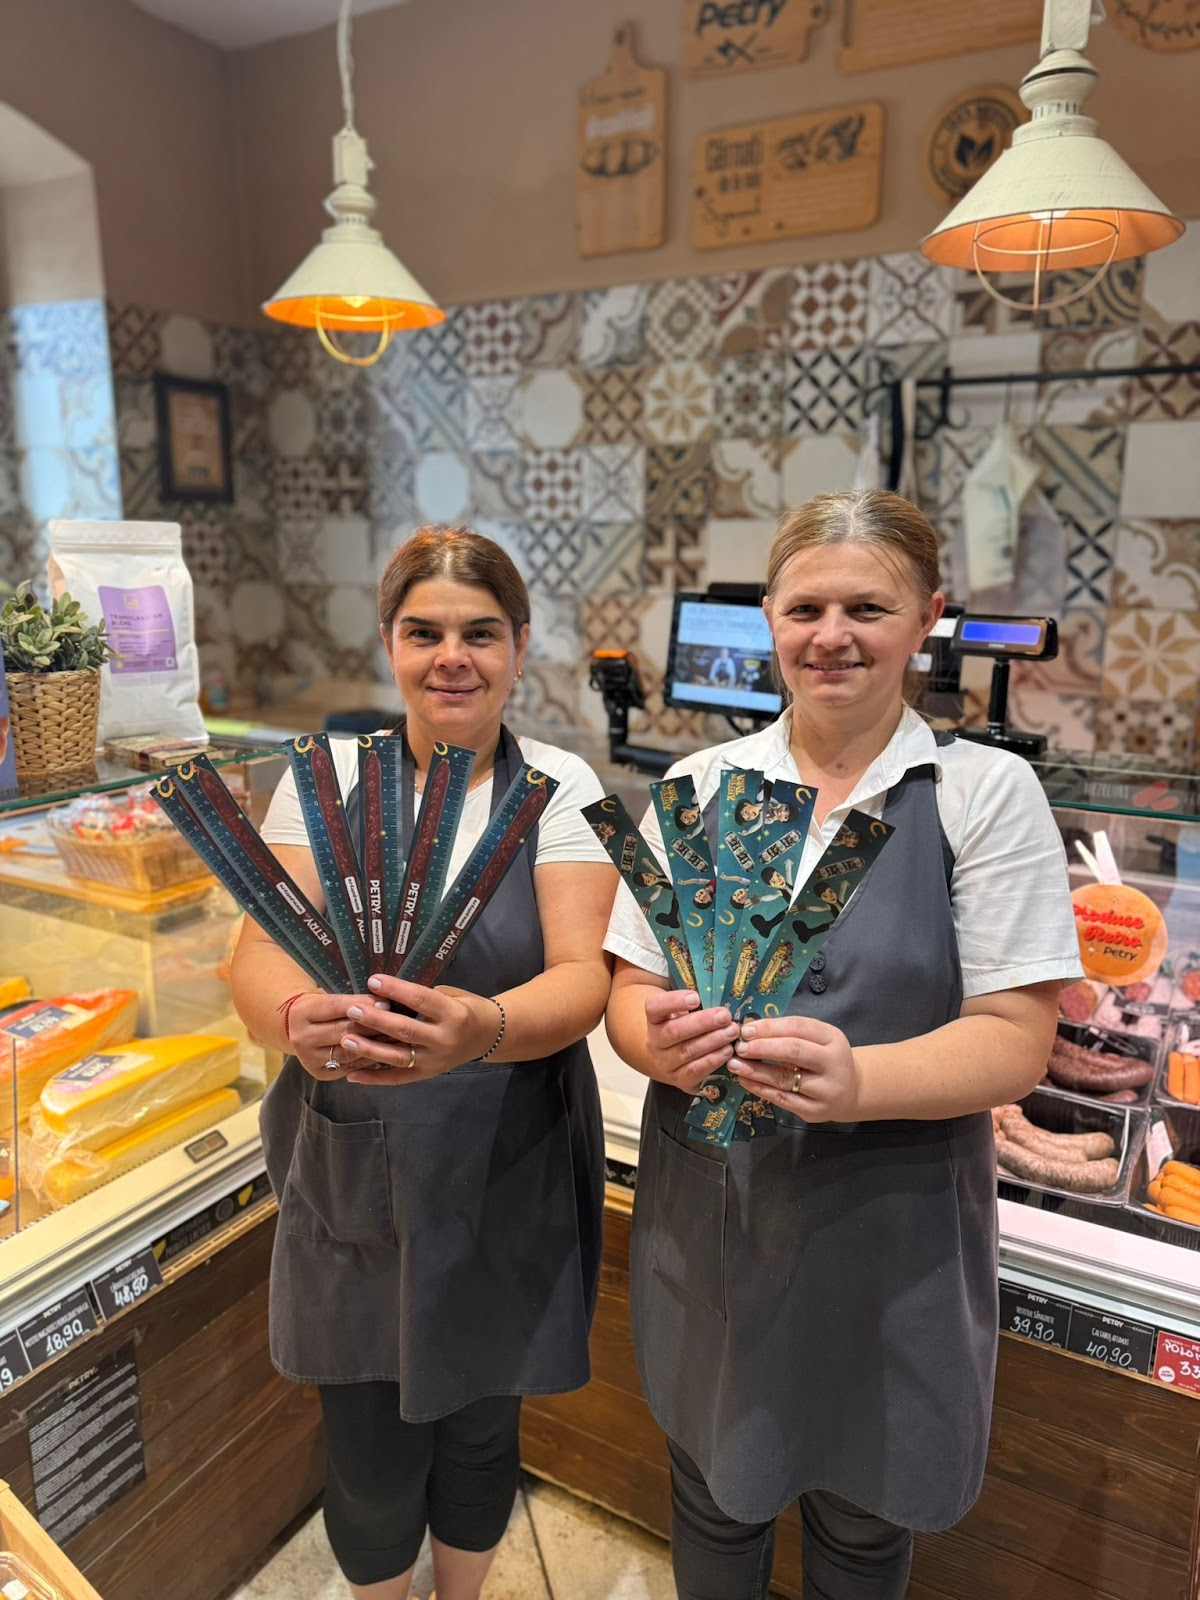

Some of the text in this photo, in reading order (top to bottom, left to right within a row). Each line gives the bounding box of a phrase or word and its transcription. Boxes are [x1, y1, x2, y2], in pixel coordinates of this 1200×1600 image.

[110, 613, 164, 621] TRANSYLVAAN
[370, 879, 382, 915] PETRY
[404, 882, 420, 917] PETRY
[303, 917, 333, 947] PETRY
[434, 930, 458, 961] PETRY
[1083, 924, 1143, 948] Retro
[114, 1274, 149, 1307] 48,50
[1027, 1293, 1048, 1305] PETRY
[43, 1302, 62, 1319] PETRY
[1102, 1315, 1125, 1329] PETRY
[45, 1318, 84, 1357] 18,90
[1009, 1315, 1055, 1343] 39,90
[1085, 1340, 1132, 1367] 40,90
[68, 1366, 96, 1390] PETRY
